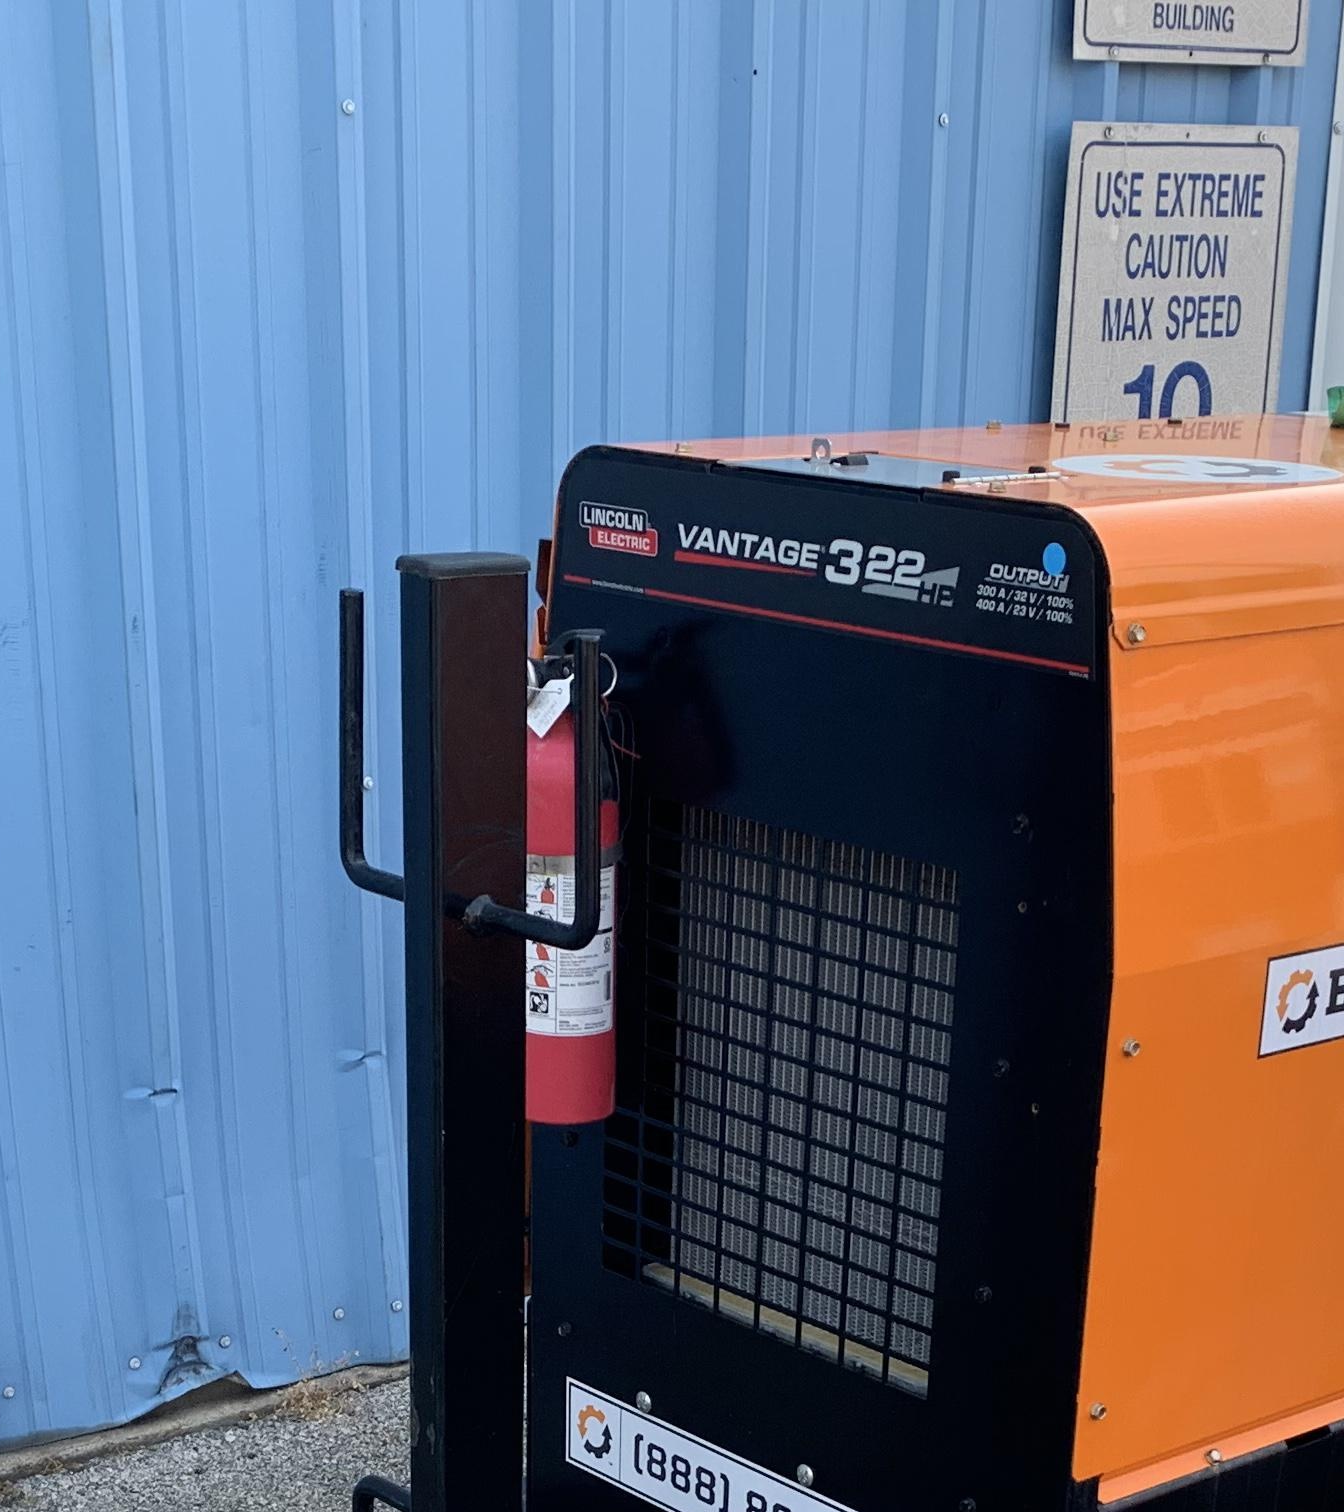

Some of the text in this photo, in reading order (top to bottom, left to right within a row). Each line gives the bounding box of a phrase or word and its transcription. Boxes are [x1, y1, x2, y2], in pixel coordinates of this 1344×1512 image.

[1153, 4, 1235, 32] BUILDING
[1094, 171, 1266, 219] USE EXTREME
[1124, 233, 1228, 280] CAUTION
[1100, 294, 1242, 342] MAX SPEED
[583, 506, 644, 531] LINCOLN
[597, 531, 651, 550] ELECTRIC
[677, 523, 820, 570] VANTAGE
[824, 538, 926, 588] 322
[989, 563, 1064, 587] OUTPUT
[976, 584, 996, 597] 300
[997, 588, 1006, 599] A
[1013, 590, 1028, 602] 32
[1029, 592, 1038, 604] V
[1046, 595, 1074, 610] 100%
[975, 598, 996, 611] 400
[996, 602, 1005, 613] A
[1012, 604, 1027, 616] 23
[1028, 606, 1037, 618] V
[1045, 609, 1073, 624] 100%
